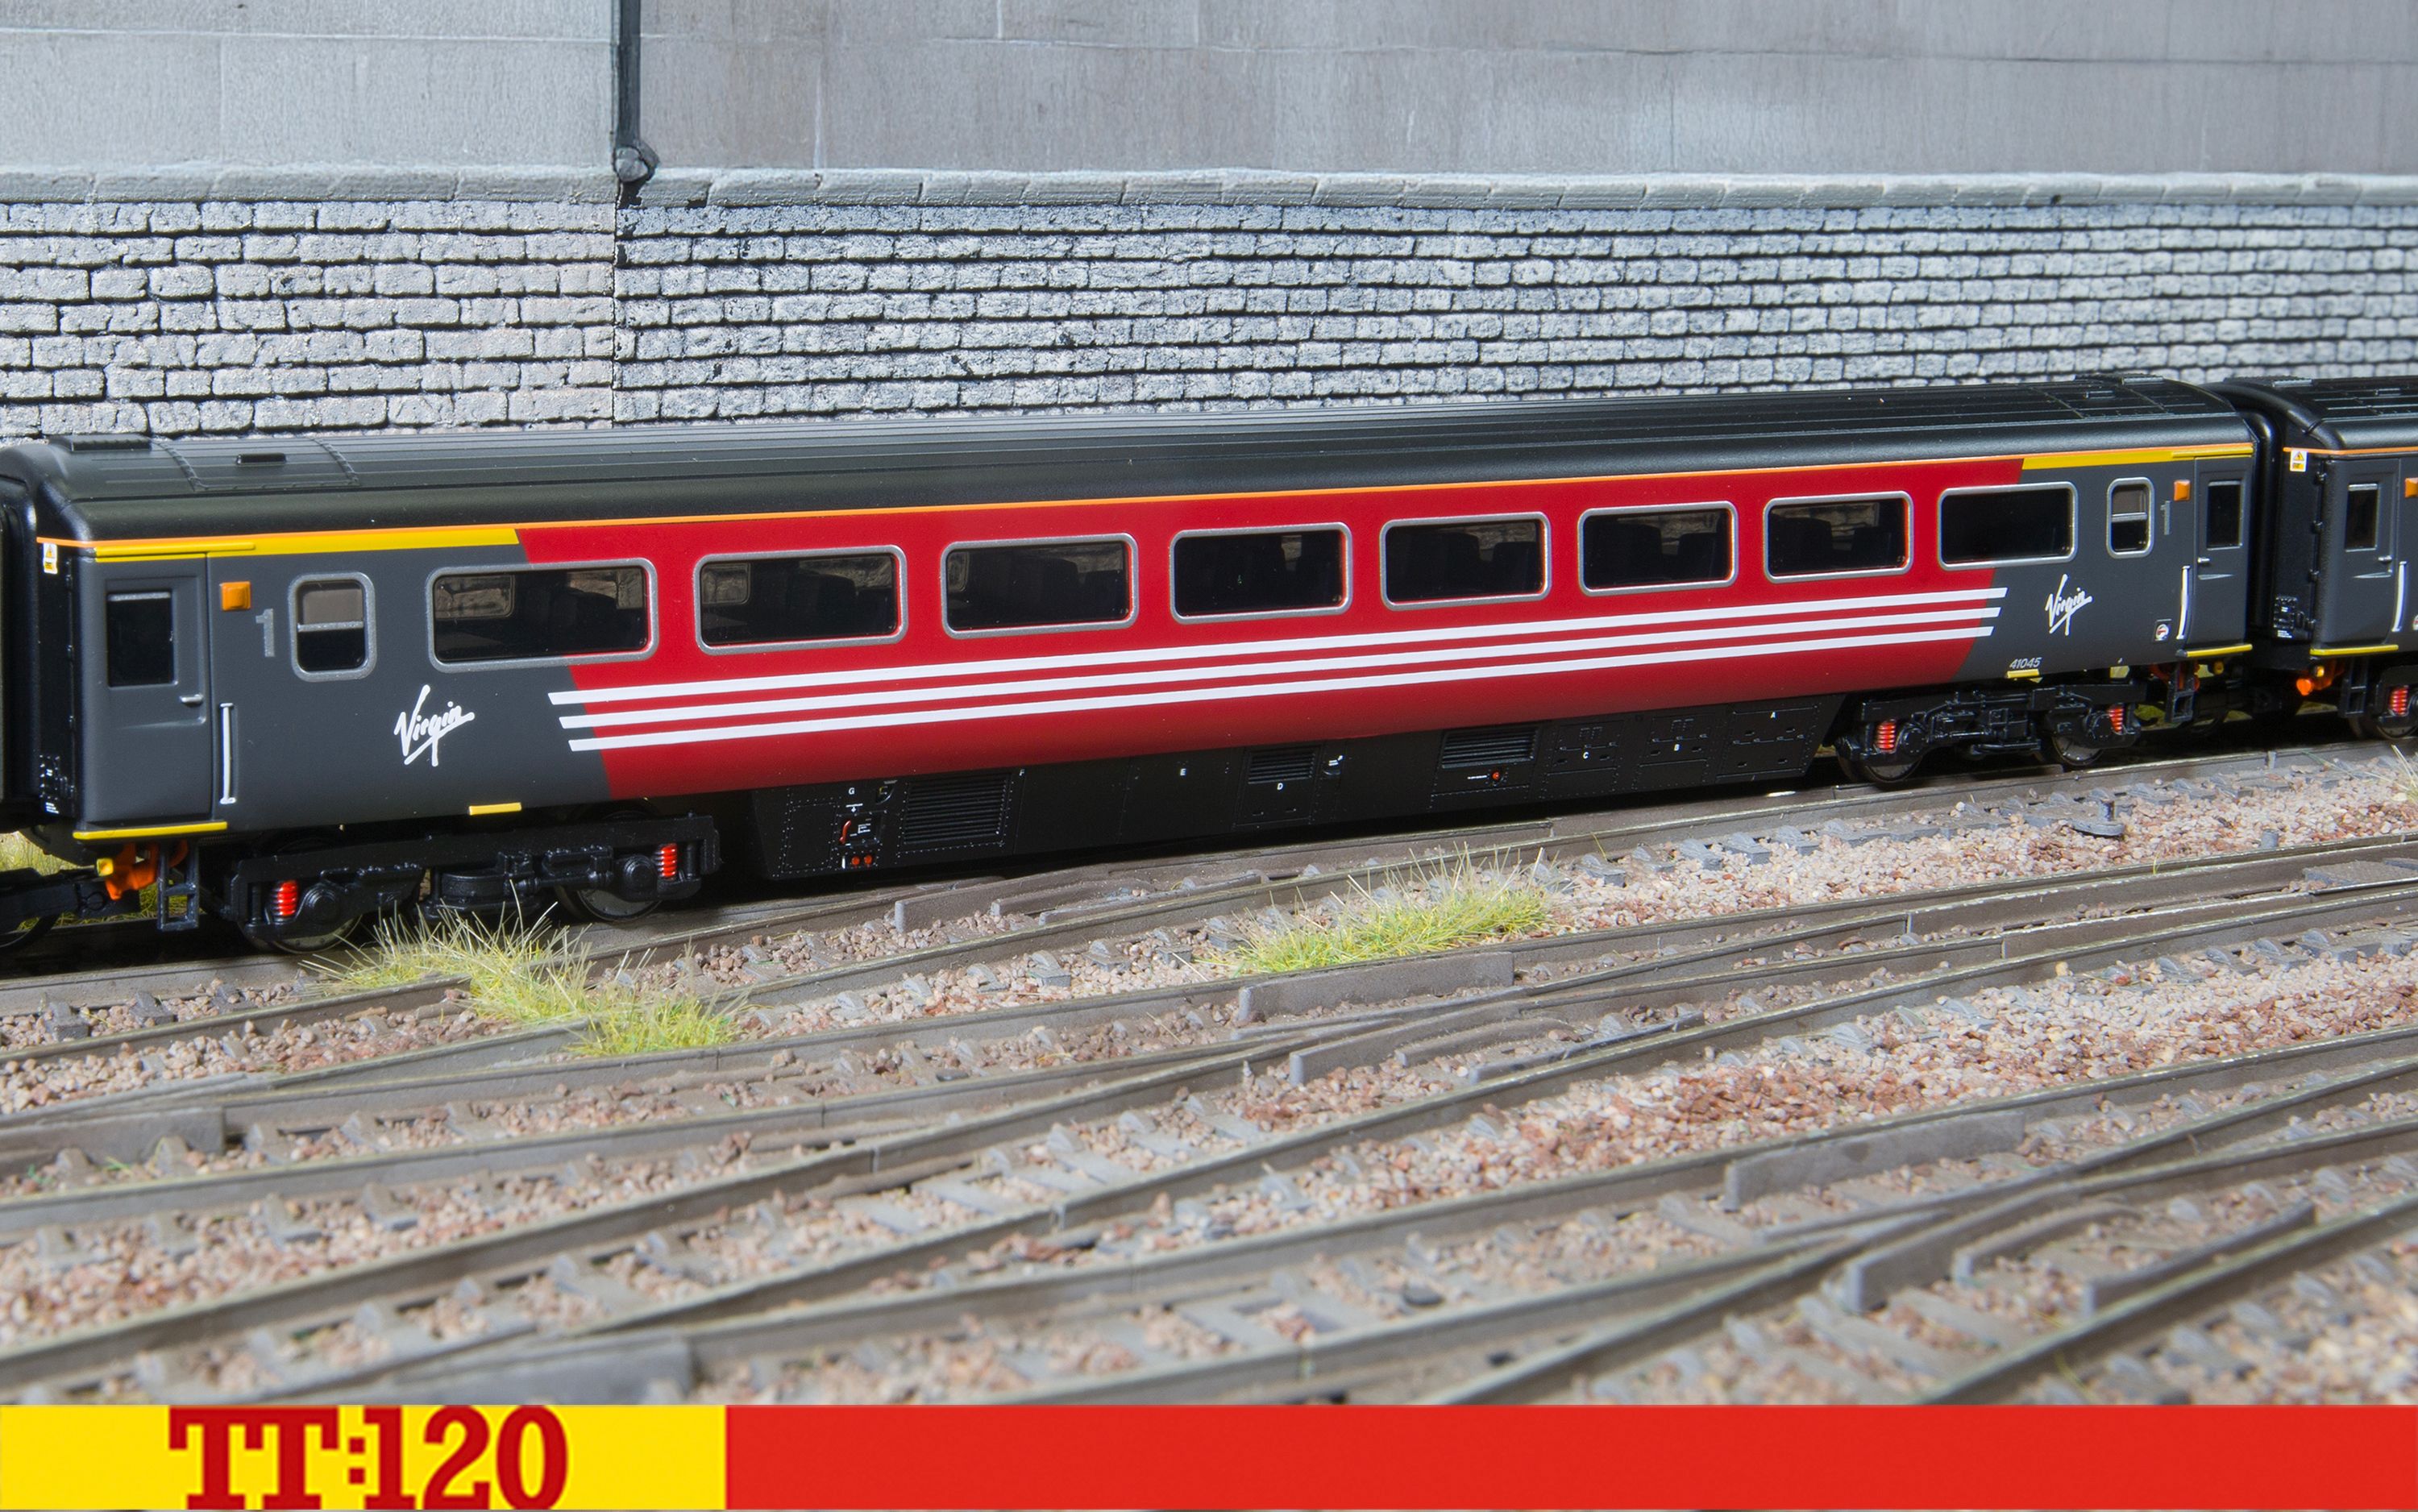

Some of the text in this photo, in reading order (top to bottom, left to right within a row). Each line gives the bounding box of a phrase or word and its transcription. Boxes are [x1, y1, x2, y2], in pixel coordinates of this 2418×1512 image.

[2160, 501, 2171, 535] 1
[2045, 573, 2093, 636] Virgin
[255, 608, 276, 658] 1
[2009, 657, 2043, 669] 41045
[393, 684, 476, 767] Virgin
[848, 787, 855, 795] G
